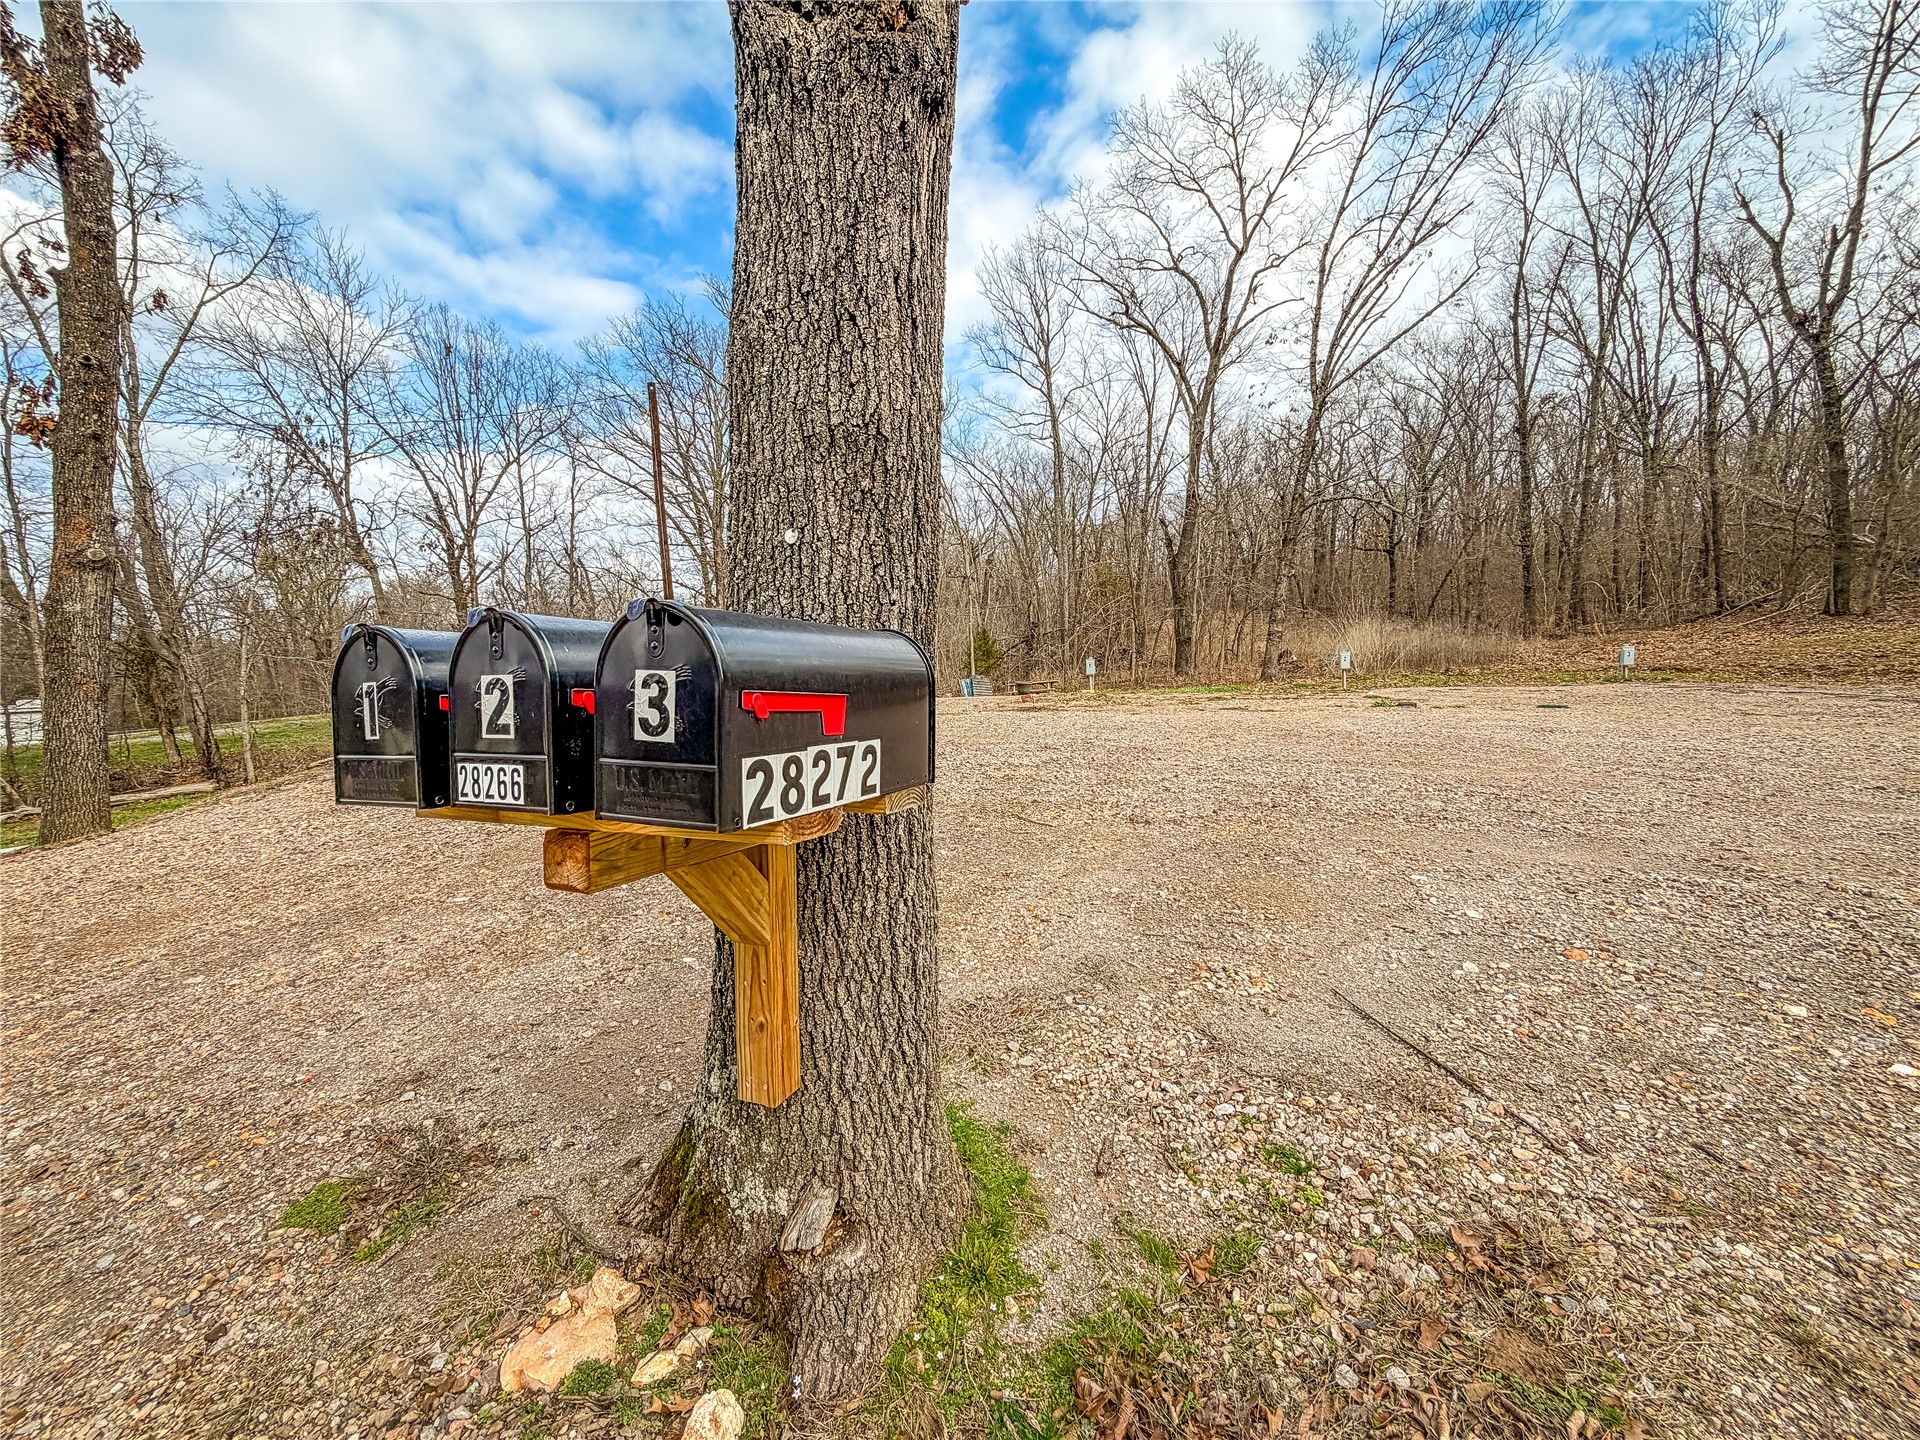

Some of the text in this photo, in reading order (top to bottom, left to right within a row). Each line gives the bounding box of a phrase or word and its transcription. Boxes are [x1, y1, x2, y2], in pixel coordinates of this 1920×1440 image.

[365, 683, 378, 738] 1
[483, 677, 512, 736] 2
[638, 673, 671, 738] 3
[459, 764, 522, 802] 28266
[745, 744, 879, 826] 28272
